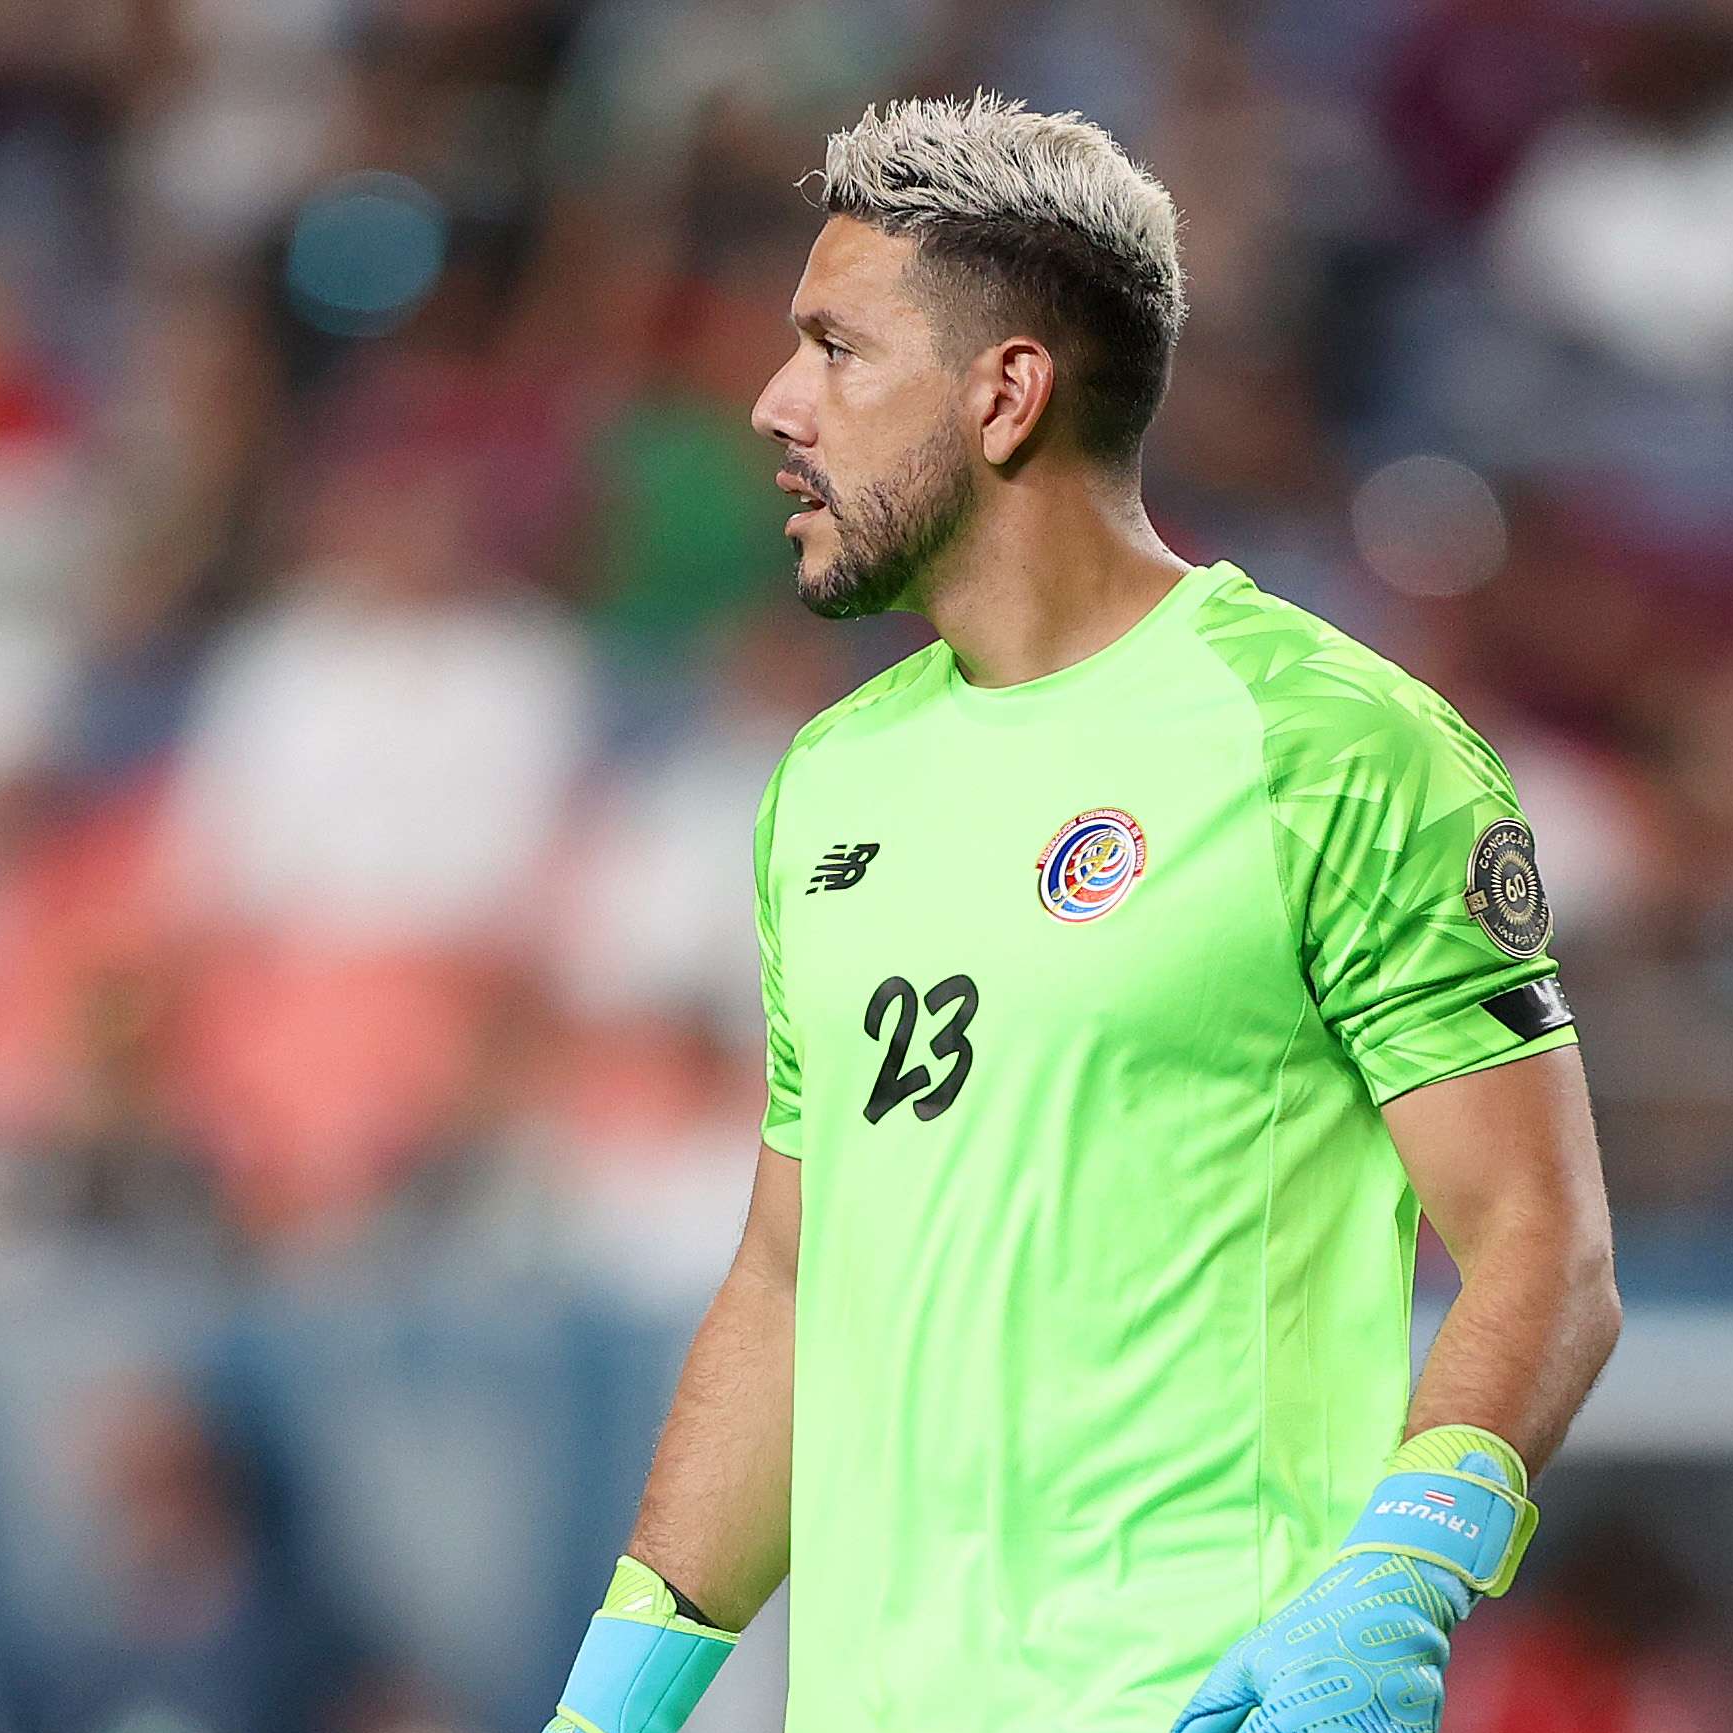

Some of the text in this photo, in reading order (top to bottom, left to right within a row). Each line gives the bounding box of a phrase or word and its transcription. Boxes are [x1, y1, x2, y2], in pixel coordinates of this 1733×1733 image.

[1478, 831, 1530, 870] CONCACAF
[1505, 873, 1527, 902] 60
[862, 973, 980, 1126] 23
